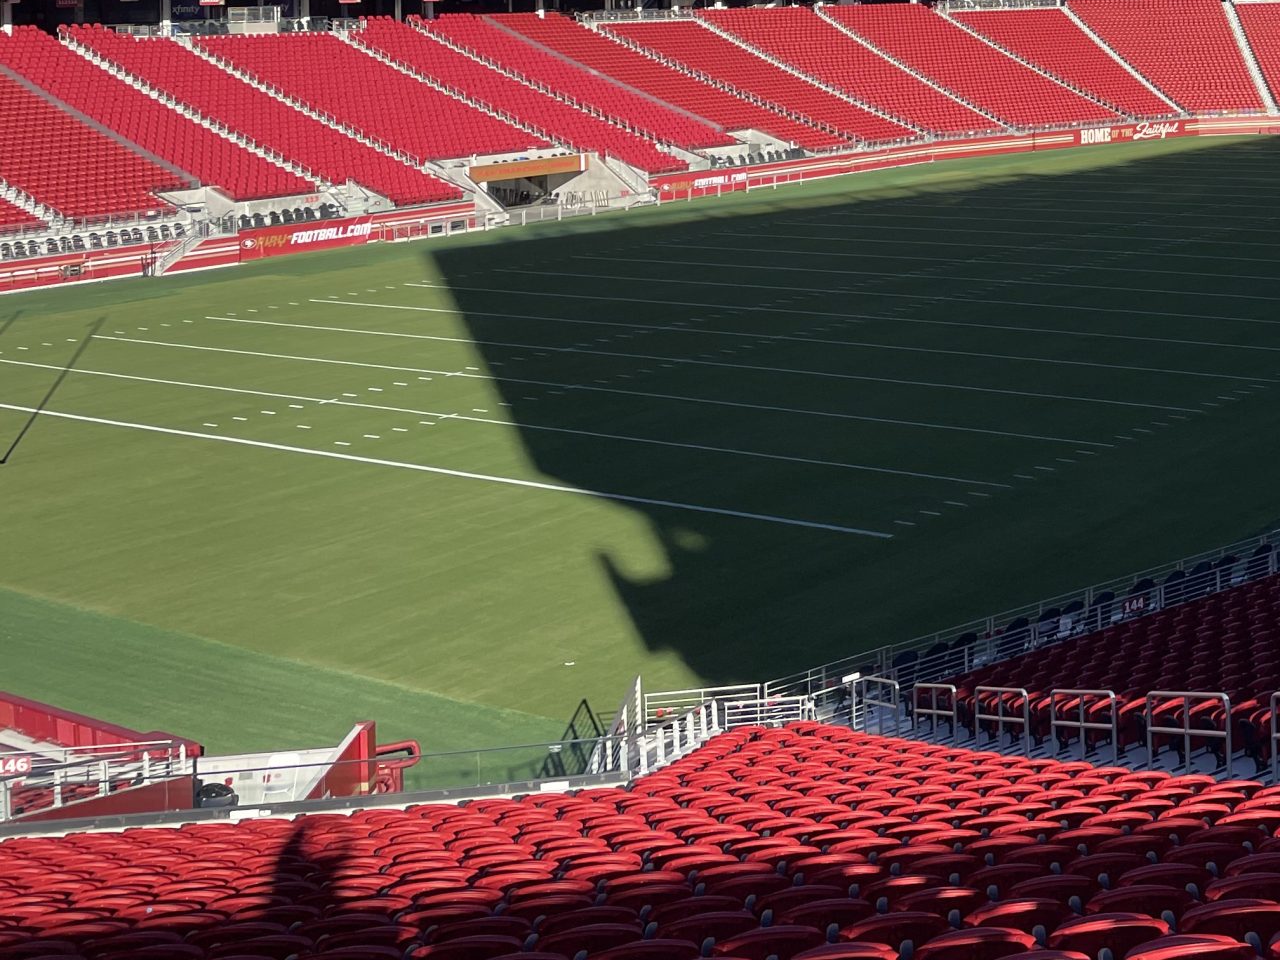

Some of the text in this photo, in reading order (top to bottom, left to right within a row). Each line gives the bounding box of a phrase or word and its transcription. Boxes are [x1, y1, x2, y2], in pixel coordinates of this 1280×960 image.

[1080, 122, 1180, 145] HOME OF THE Faithful
[1124, 597, 1145, 613] 144
